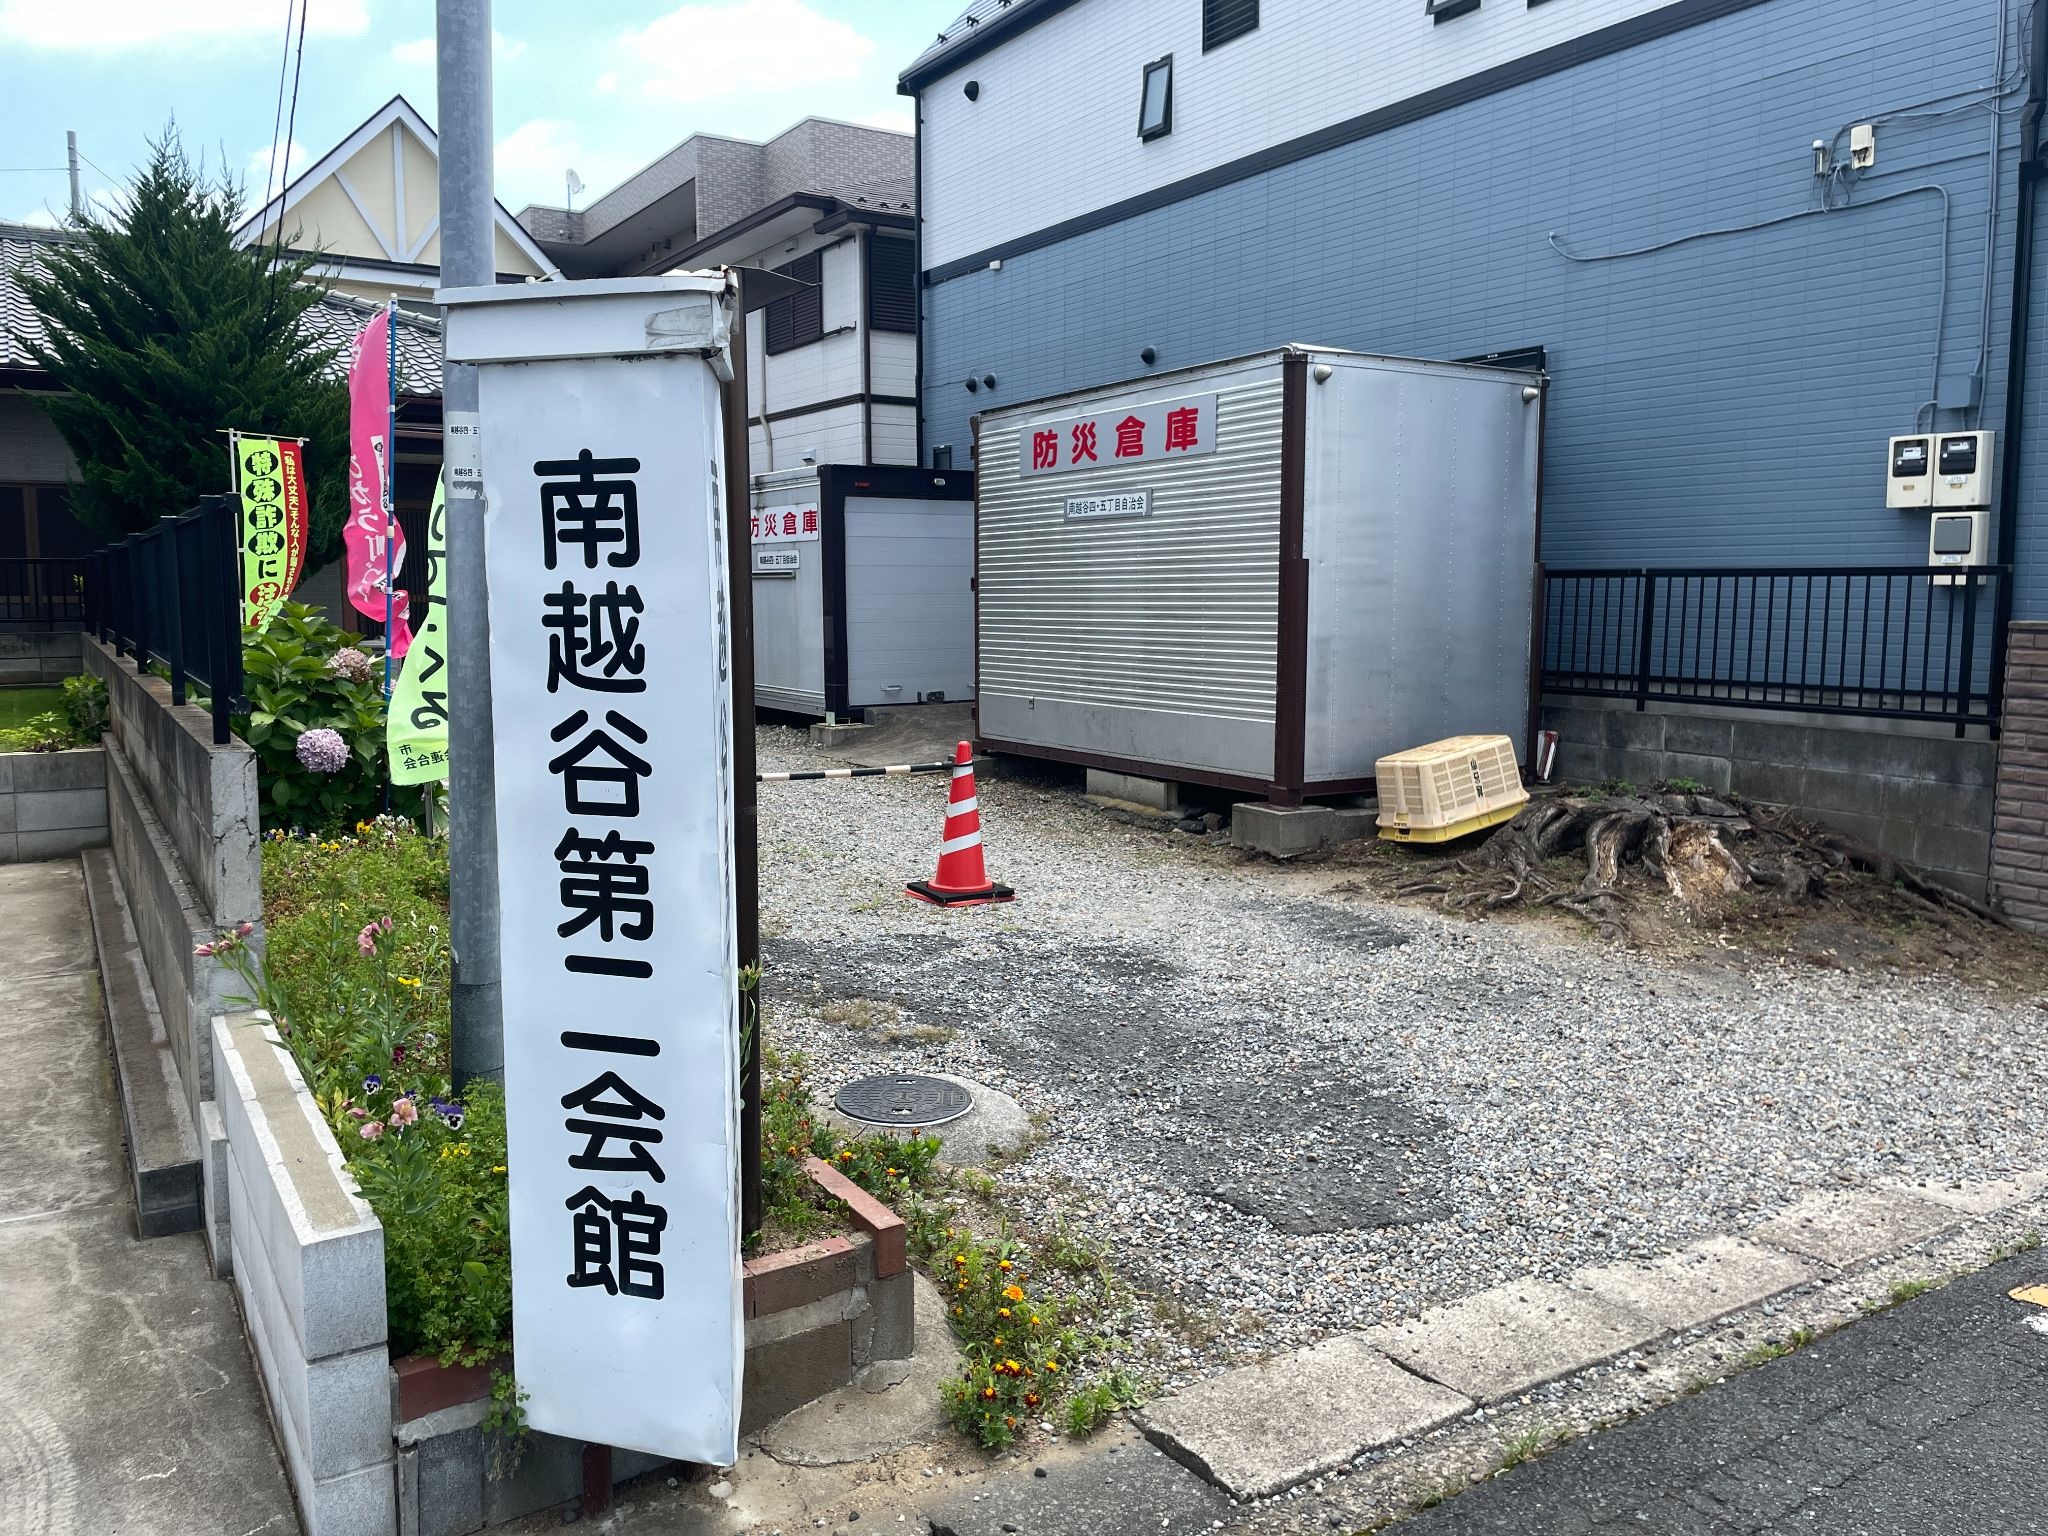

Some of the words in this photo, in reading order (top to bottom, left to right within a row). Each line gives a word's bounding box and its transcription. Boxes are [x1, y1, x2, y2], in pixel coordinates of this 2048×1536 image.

[1033, 407, 1199, 470] 防災倉庫
[250, 450, 280, 626] 特殊詐欺に注
[1068, 495, 1145, 515] 南越谷四・五丁目自治会
[534, 447, 667, 1301] 南越谷第二会館
